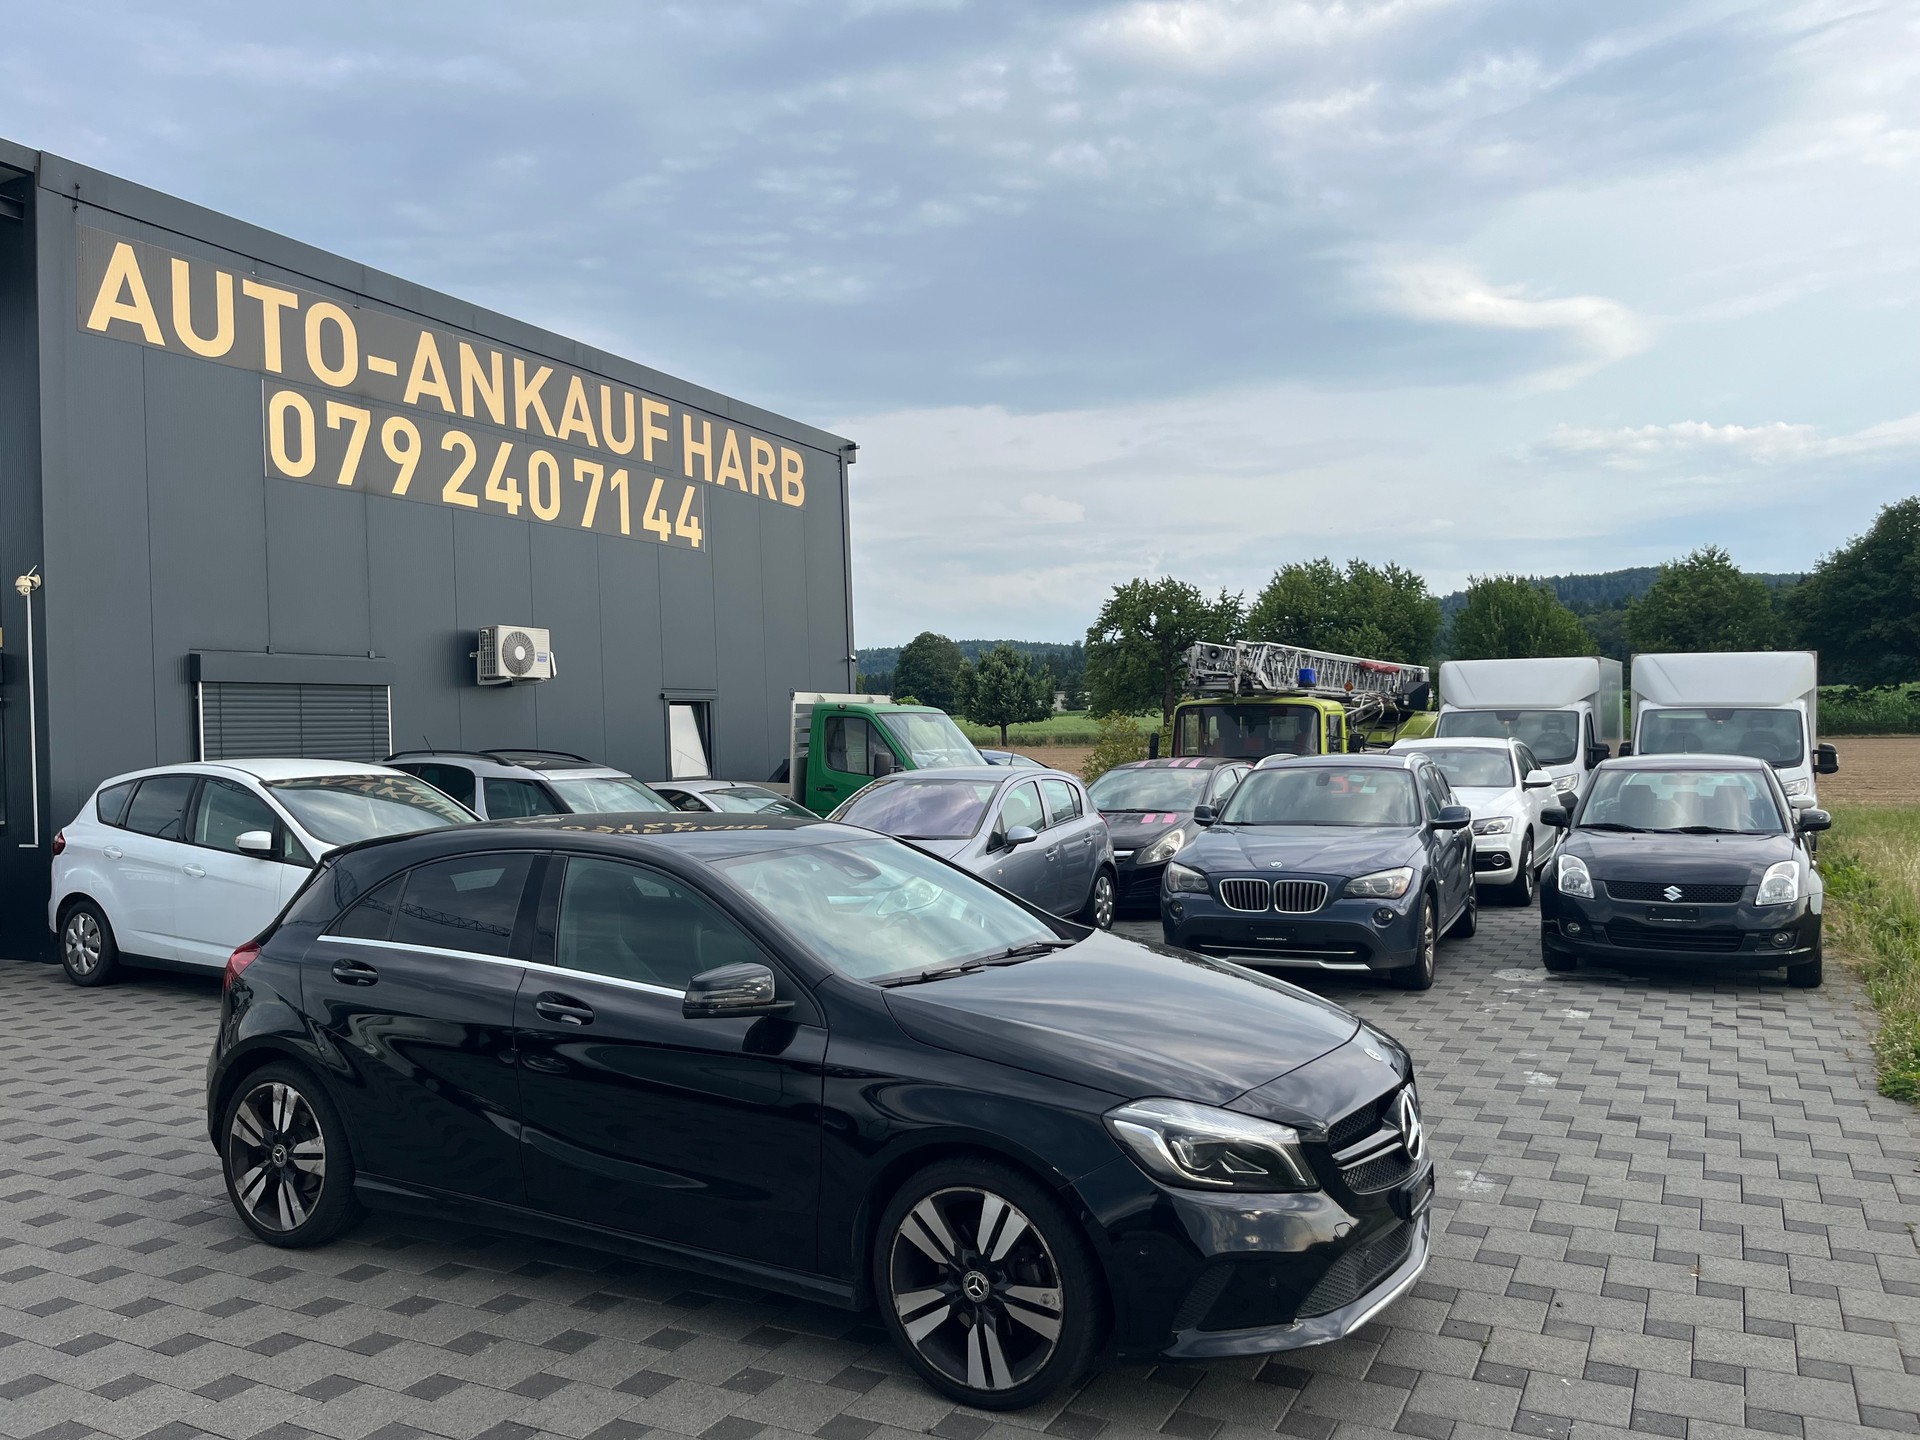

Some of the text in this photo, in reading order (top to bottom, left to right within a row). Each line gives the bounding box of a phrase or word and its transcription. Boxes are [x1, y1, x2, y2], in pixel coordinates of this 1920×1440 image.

[87, 242, 806, 506] AUTO-ANKAUF HARB
[269, 390, 422, 495] 079
[441, 430, 561, 521] 240
